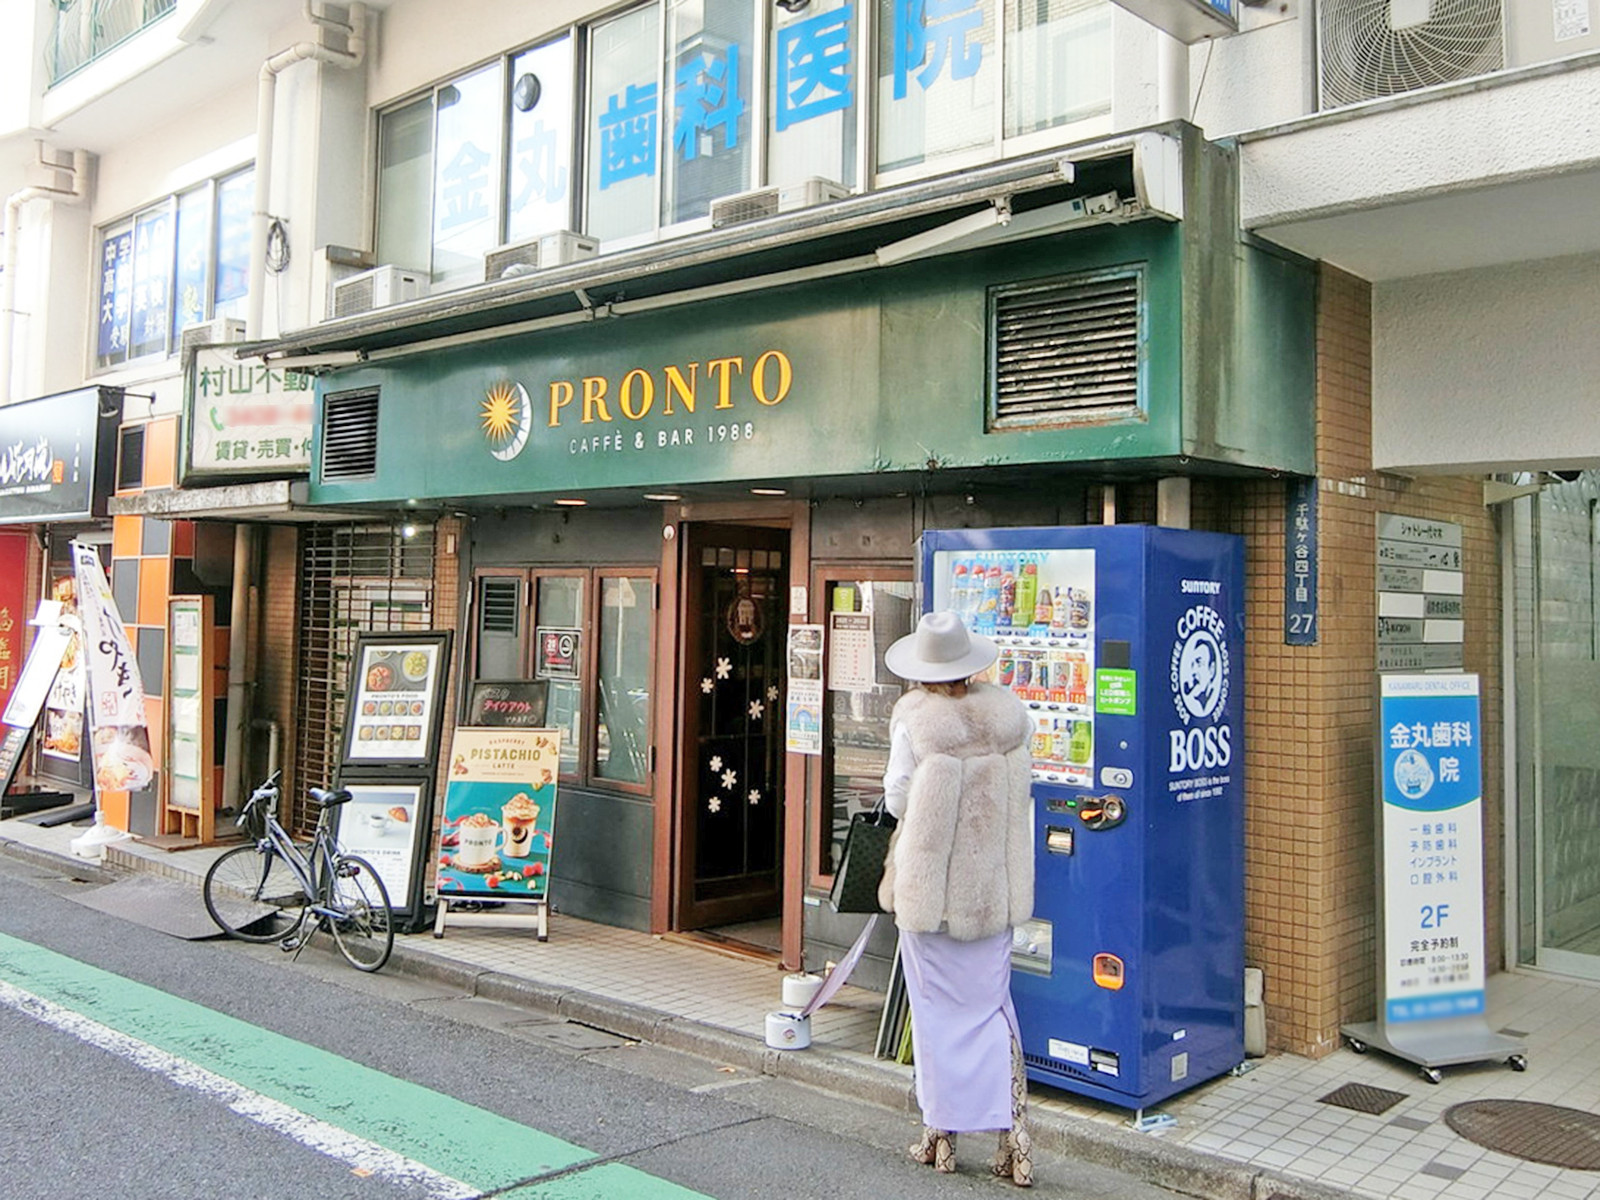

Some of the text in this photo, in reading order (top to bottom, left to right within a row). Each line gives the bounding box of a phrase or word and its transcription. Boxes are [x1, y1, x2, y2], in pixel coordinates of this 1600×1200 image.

[200, 364, 315, 397] 村山不動
[548, 350, 793, 427] PRONTO
[570, 422, 754, 454] CAFFÈ & BAR 1988
[1177, 605, 1225, 640] COFFEE
[1289, 614, 1313, 634] 27
[484, 698, 532, 713] テイクアウト
[1389, 722, 1473, 749] 金丸歯科
[470, 748, 541, 761] PISTACHIO
[1169, 724, 1231, 772] BOSS
[1439, 756, 1460, 783] 院
[1410, 823, 1457, 836] 一般歯科
[1410, 839, 1457, 852] 予防歯科
[1410, 855, 1457, 868] インプラント
[1410, 871, 1458, 885] 口腔外科
[1420, 904, 1449, 929] 2F
[1410, 936, 1459, 952] 完全予約制
